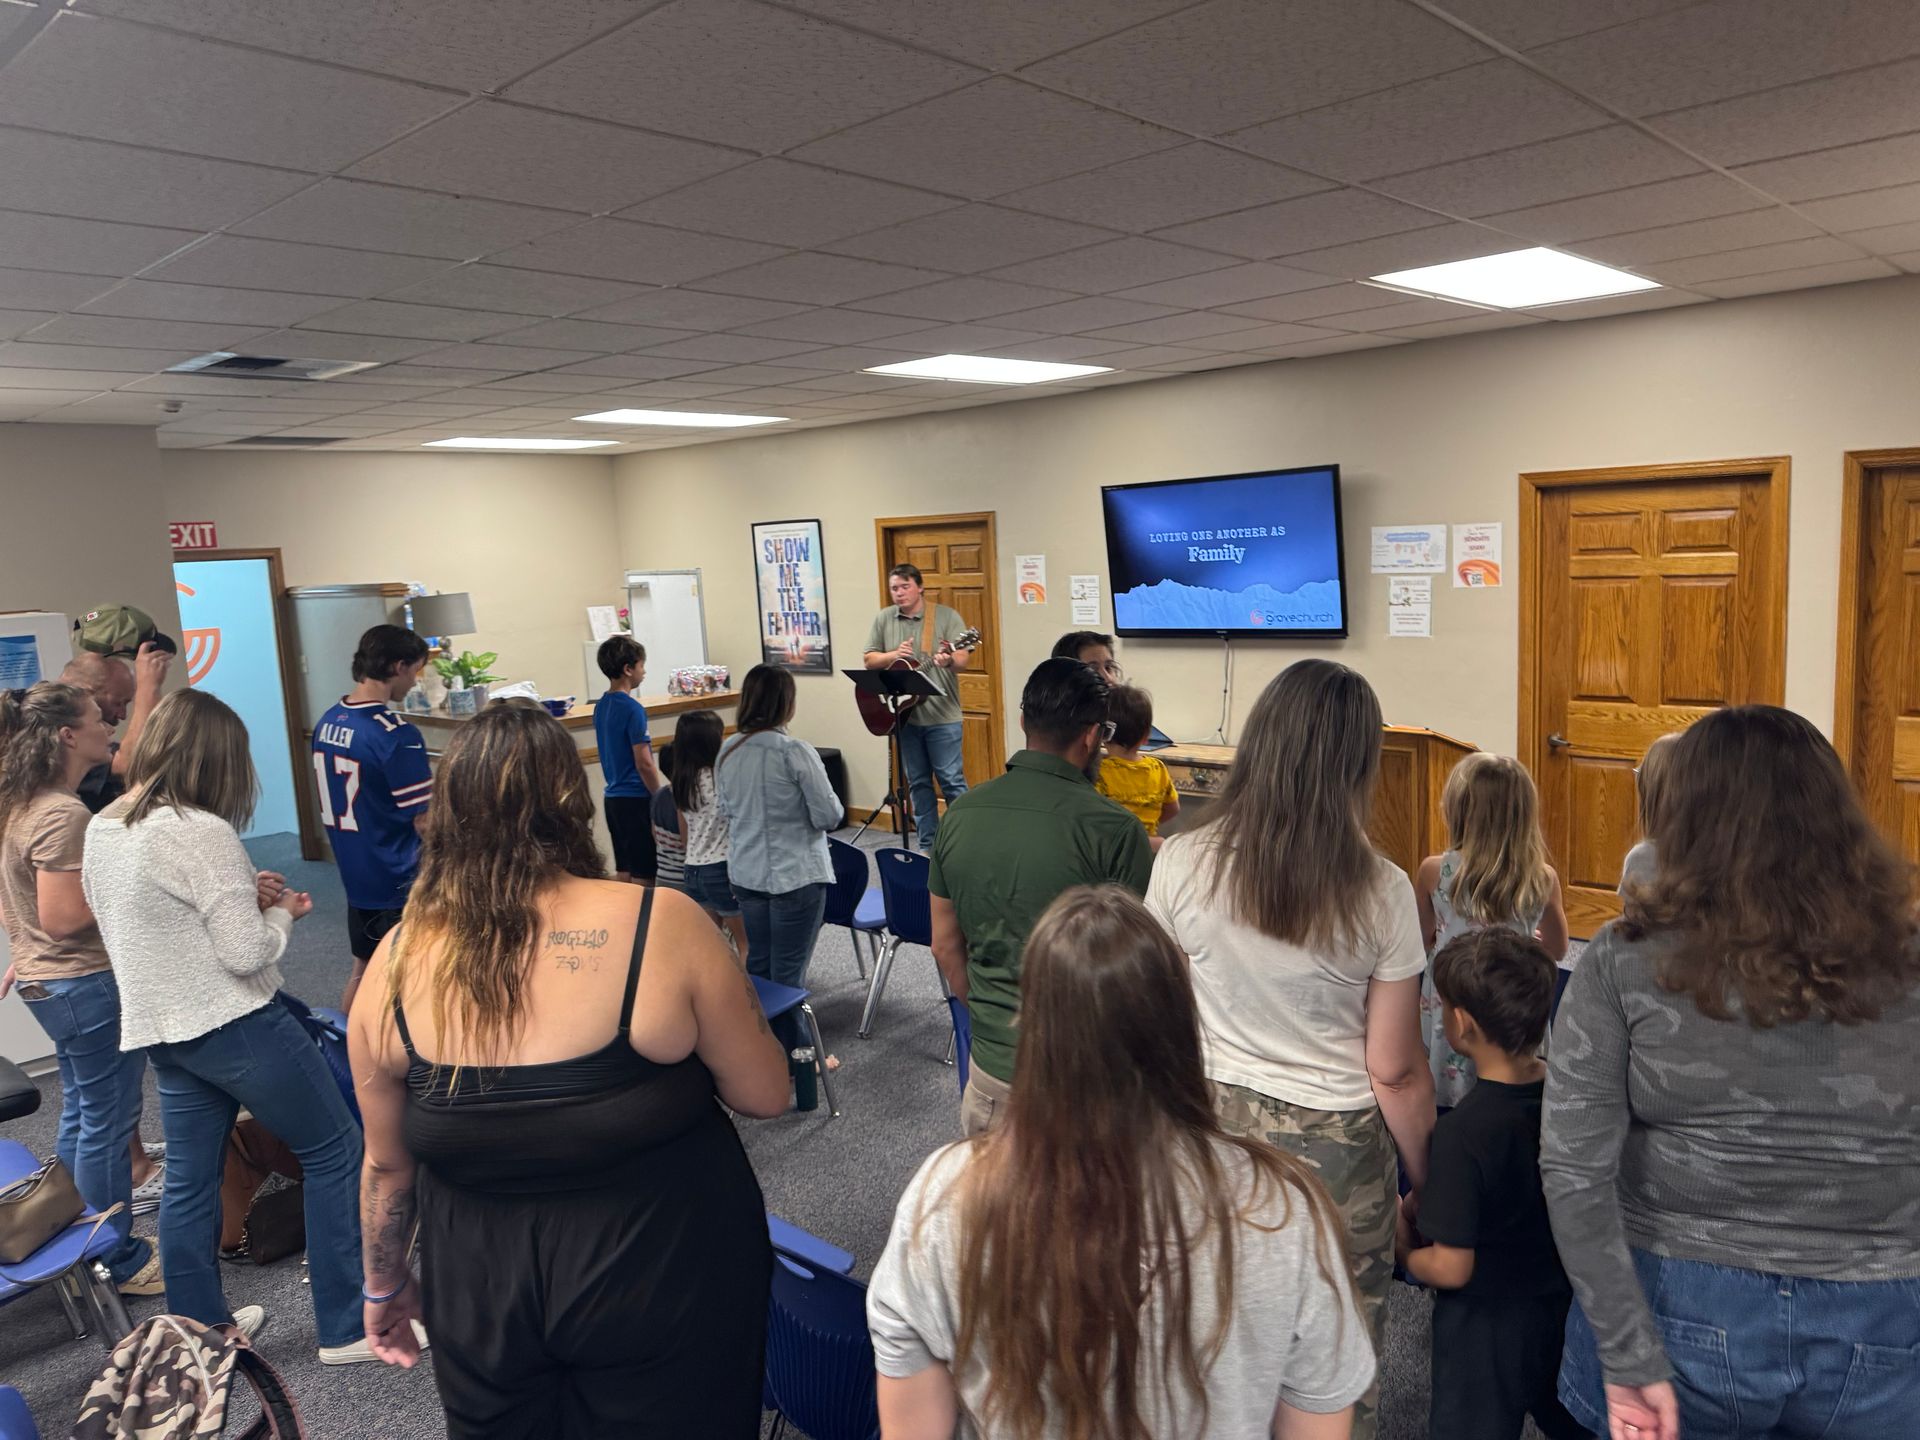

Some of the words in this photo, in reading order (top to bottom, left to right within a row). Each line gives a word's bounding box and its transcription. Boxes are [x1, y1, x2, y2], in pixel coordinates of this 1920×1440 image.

[1149, 532, 1189, 543] LOVING
[1191, 530, 1213, 541] ONE
[1216, 528, 1268, 540] ANOTHER
[1270, 526, 1286, 536] AS
[764, 537, 810, 563] SHOW
[1187, 543, 1246, 564] Family
[779, 563, 801, 587] ME
[777, 587, 806, 612] THE
[767, 612, 822, 636] FATHER
[319, 722, 355, 749] ALLEN
[313, 751, 360, 832] 17
